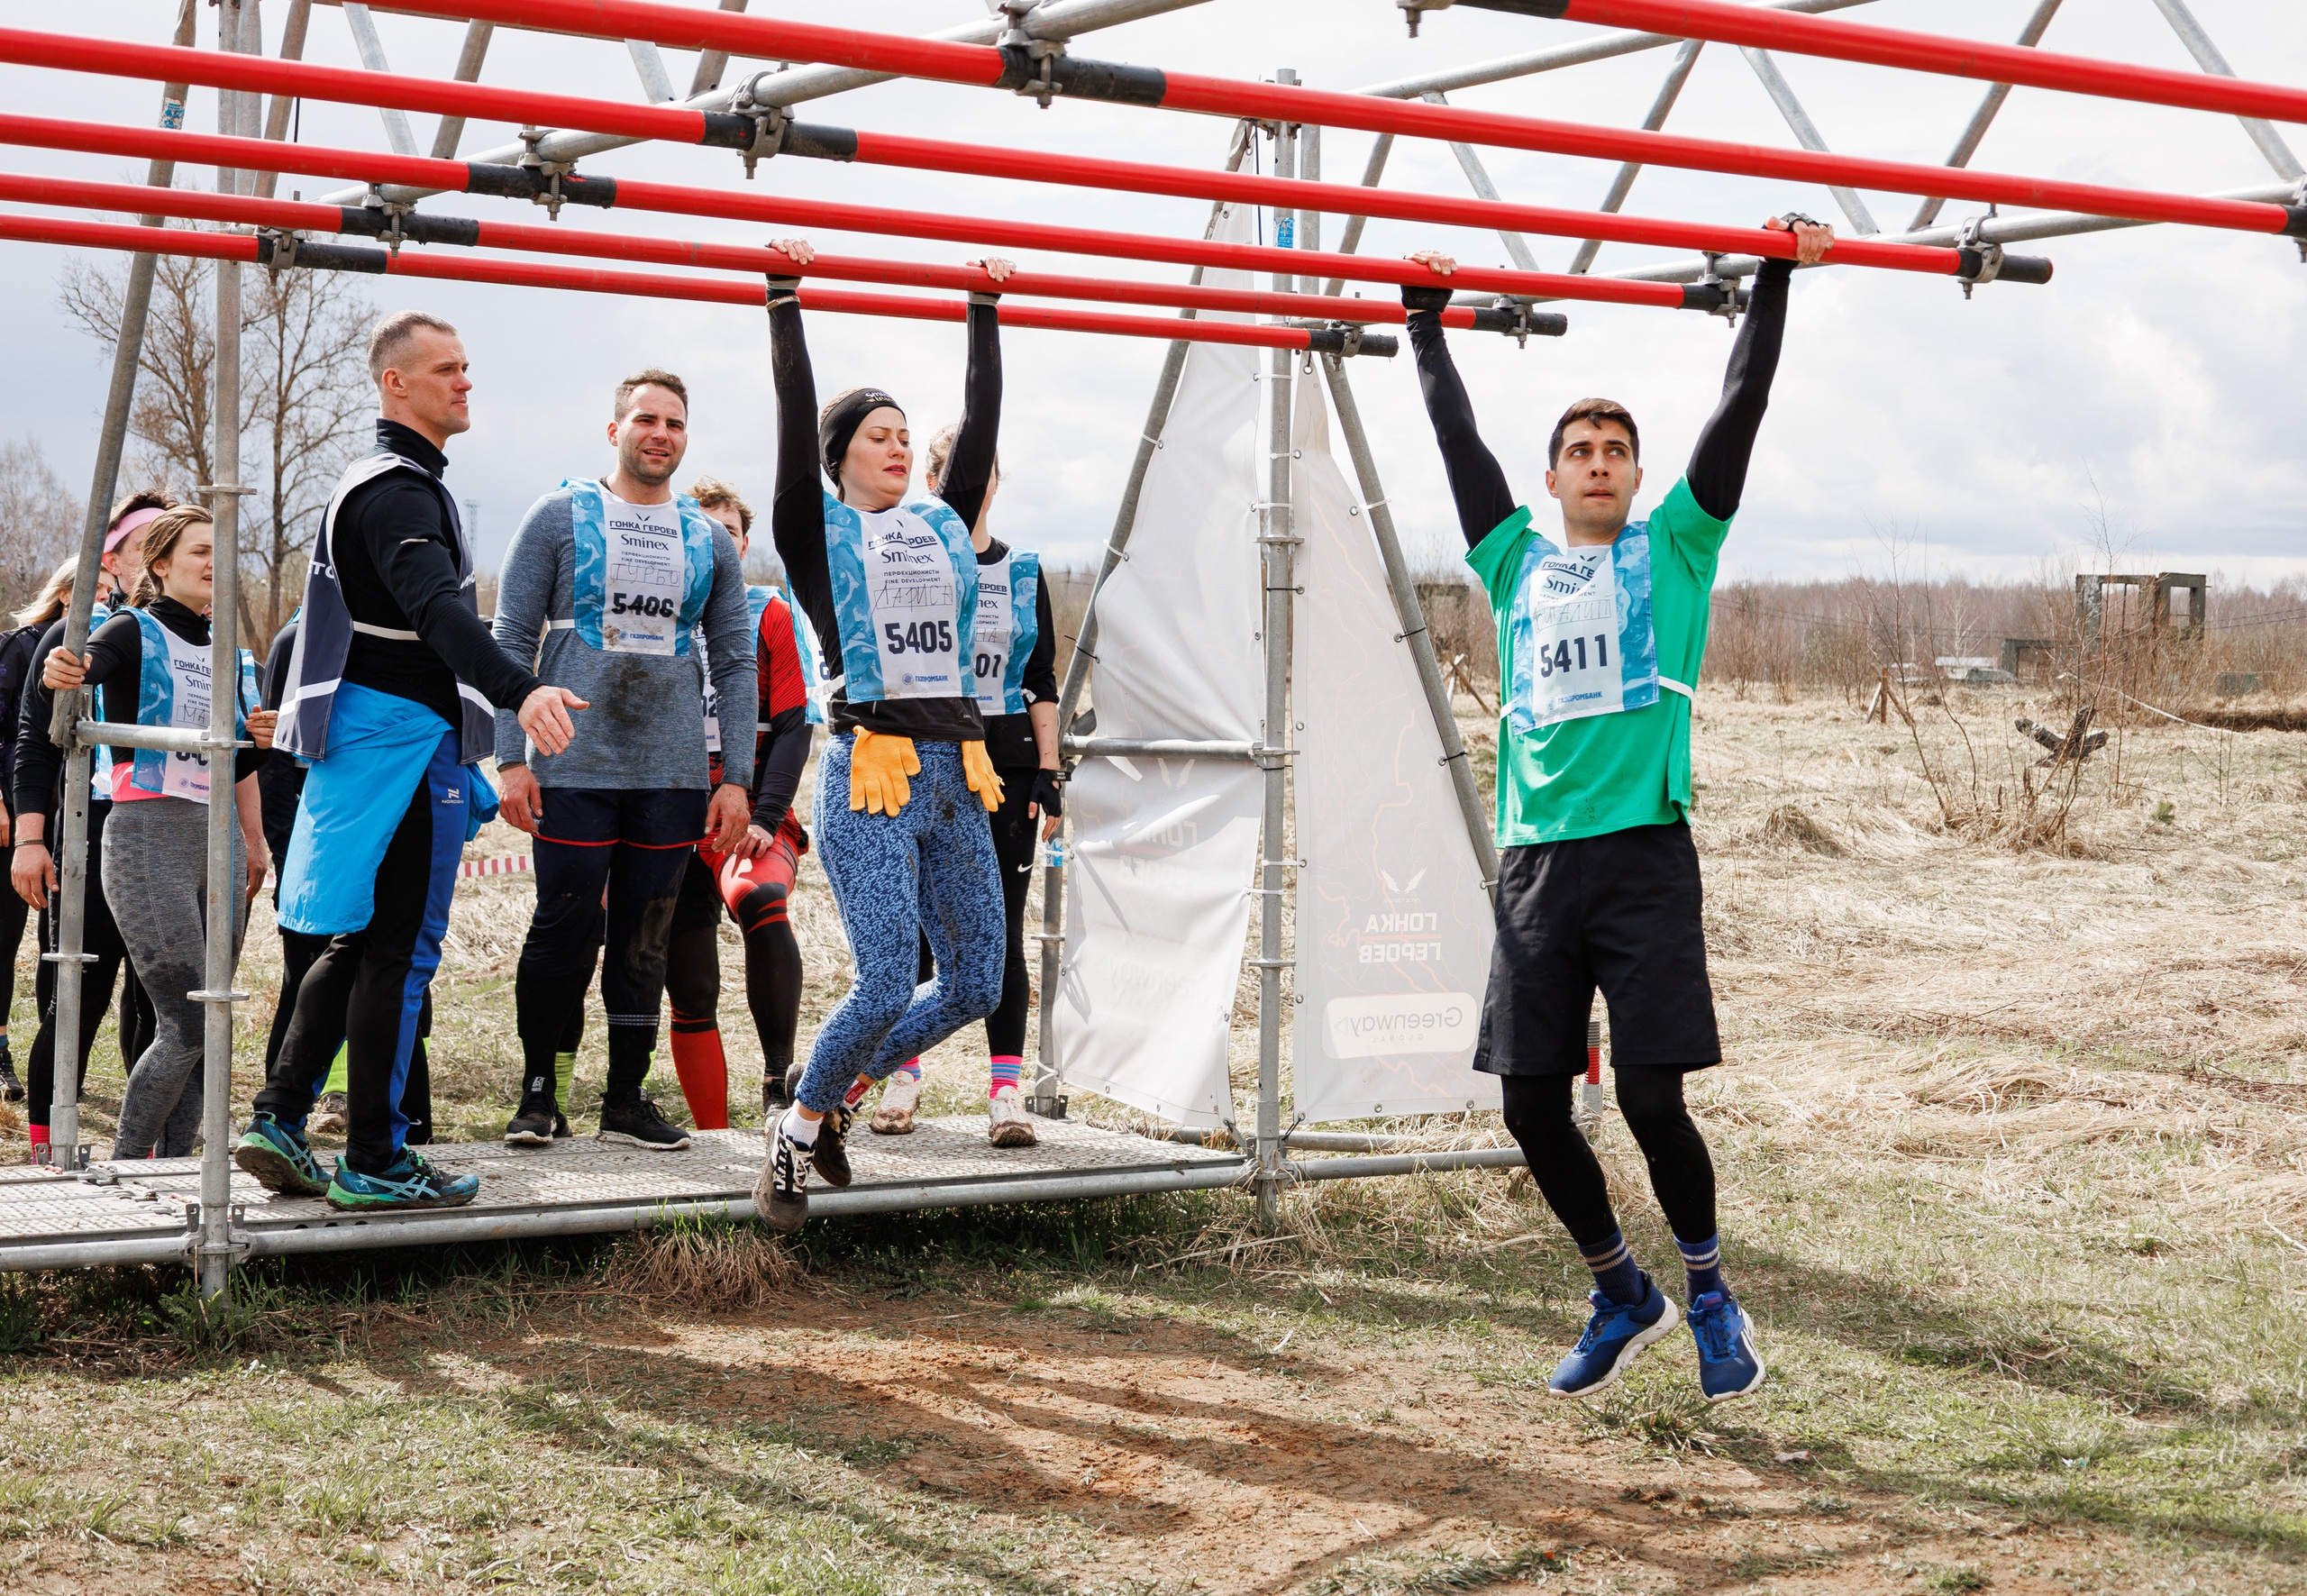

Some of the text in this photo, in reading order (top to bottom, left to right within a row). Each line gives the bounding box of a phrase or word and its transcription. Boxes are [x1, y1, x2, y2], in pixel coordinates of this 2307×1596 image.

[609, 520, 678, 536] ГОНКА ГЕРОЕВ
[621, 534, 670, 551] Sminex
[634, 559, 670, 567] DEVELOPMENT
[880, 548, 935, 564] Sminex
[883, 569, 940, 578] ПЕРФЕКЦИОНИСТЫ
[1542, 561, 1595, 579] ГОНКА ГЕ
[979, 582, 1008, 593] ЕРОЕВ
[611, 592, 674, 618] 5406
[977, 598, 998, 609] nex
[884, 620, 953, 655] 5405
[1540, 634, 1608, 679] 5411
[174, 659, 201, 671] ГОНКА
[975, 652, 1002, 679] 01
[915, 675, 949, 683] ГАЗПРОМБАНК
[1557, 690, 1603, 705] ГАЗПРОМБАНК
